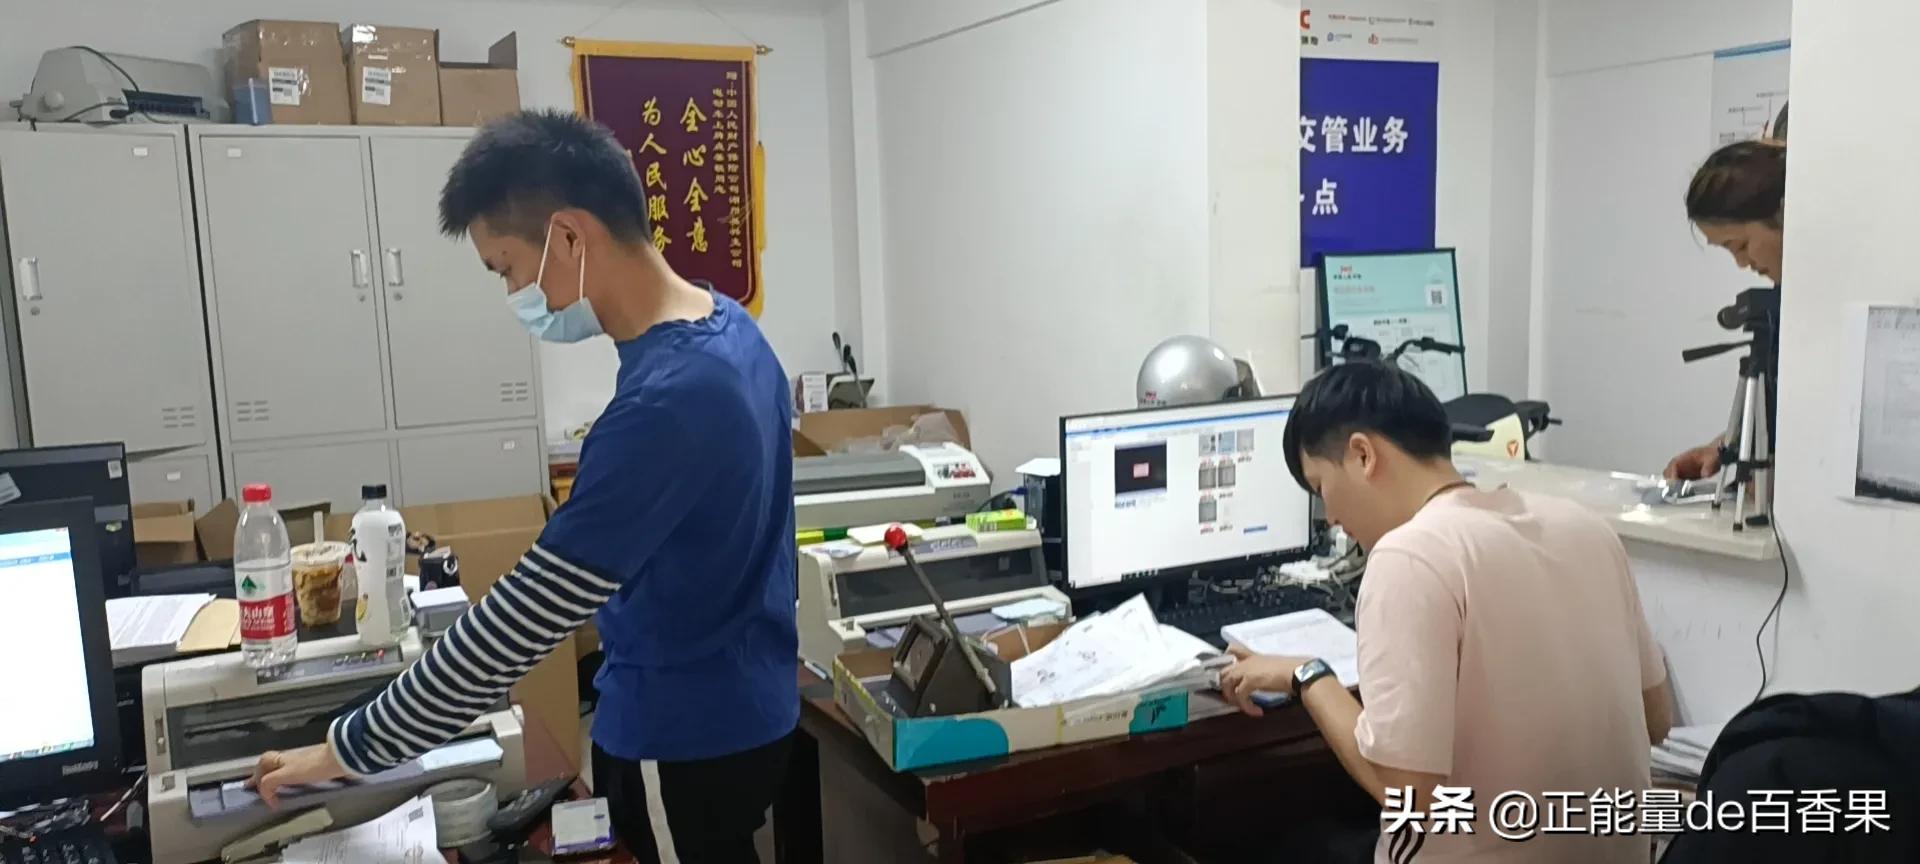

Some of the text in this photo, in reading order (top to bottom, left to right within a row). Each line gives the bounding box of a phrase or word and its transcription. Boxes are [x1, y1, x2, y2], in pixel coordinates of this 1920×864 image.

[639, 96, 672, 253] 为人民服务
[680, 97, 709, 253] 全心全意
[1300, 115, 1409, 154] 交管业务
